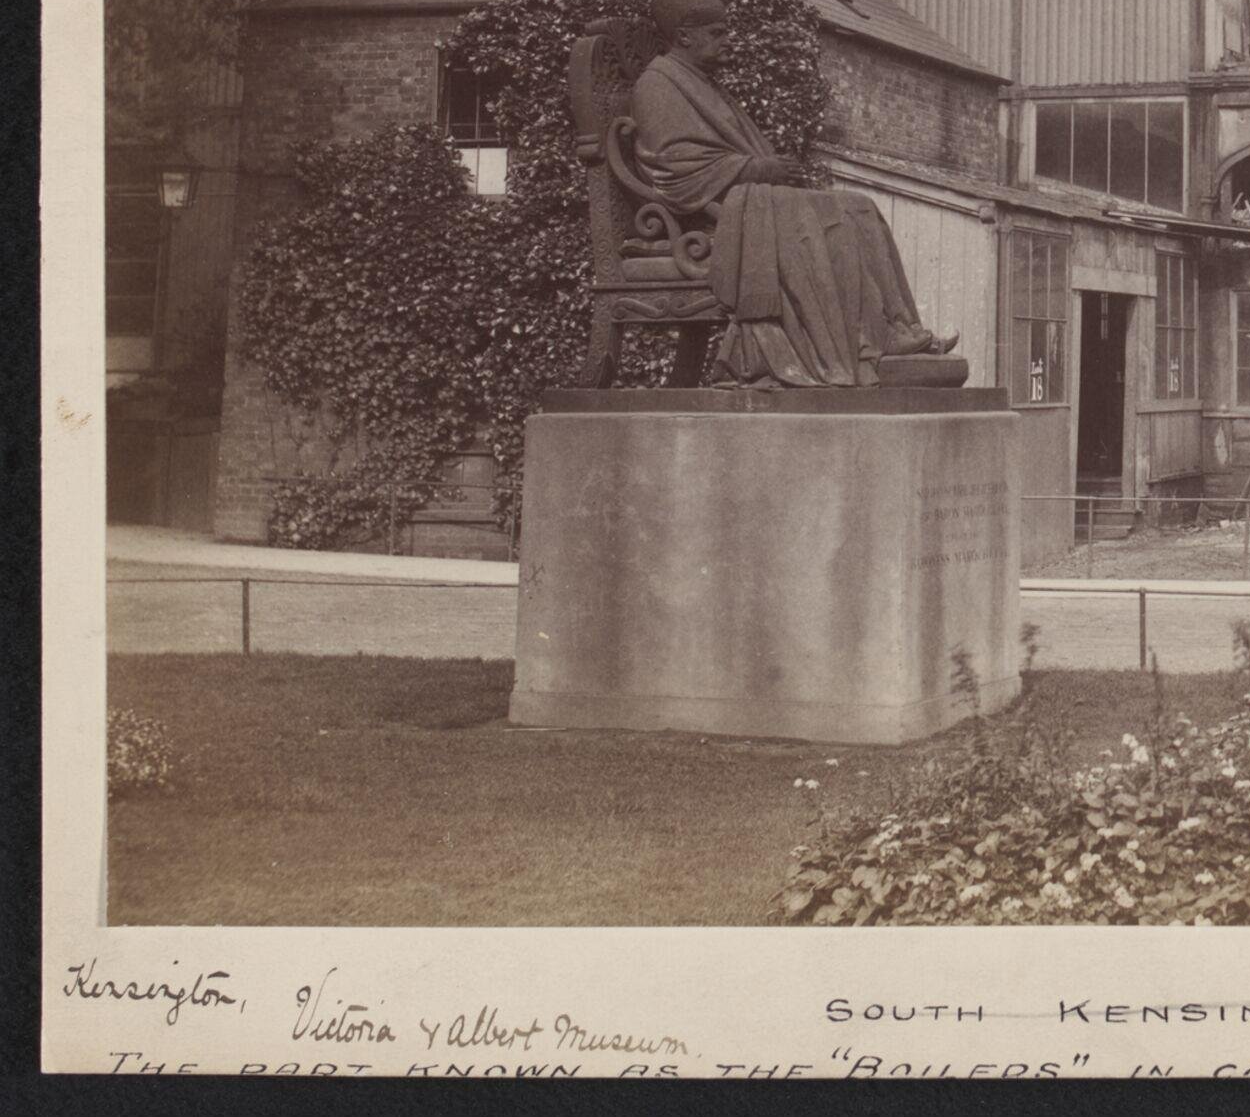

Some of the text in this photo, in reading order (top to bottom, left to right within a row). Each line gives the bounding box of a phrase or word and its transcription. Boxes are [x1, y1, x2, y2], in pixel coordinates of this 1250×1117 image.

[1031, 376, 1044, 401] 18
[63, 957, 247, 1026] Kensington,
[292, 966, 397, 1043] Victoria
[447, 1004, 543, 1051] Albert
[554, 1013, 702, 1059] Museum.
[826, 998, 984, 1024] SOUTH
[109, 1051, 199, 1075] THE
[619, 1063, 679, 1078] AS
[715, 1064, 814, 1080] THE
[1131, 1064, 1174, 1079] IN
